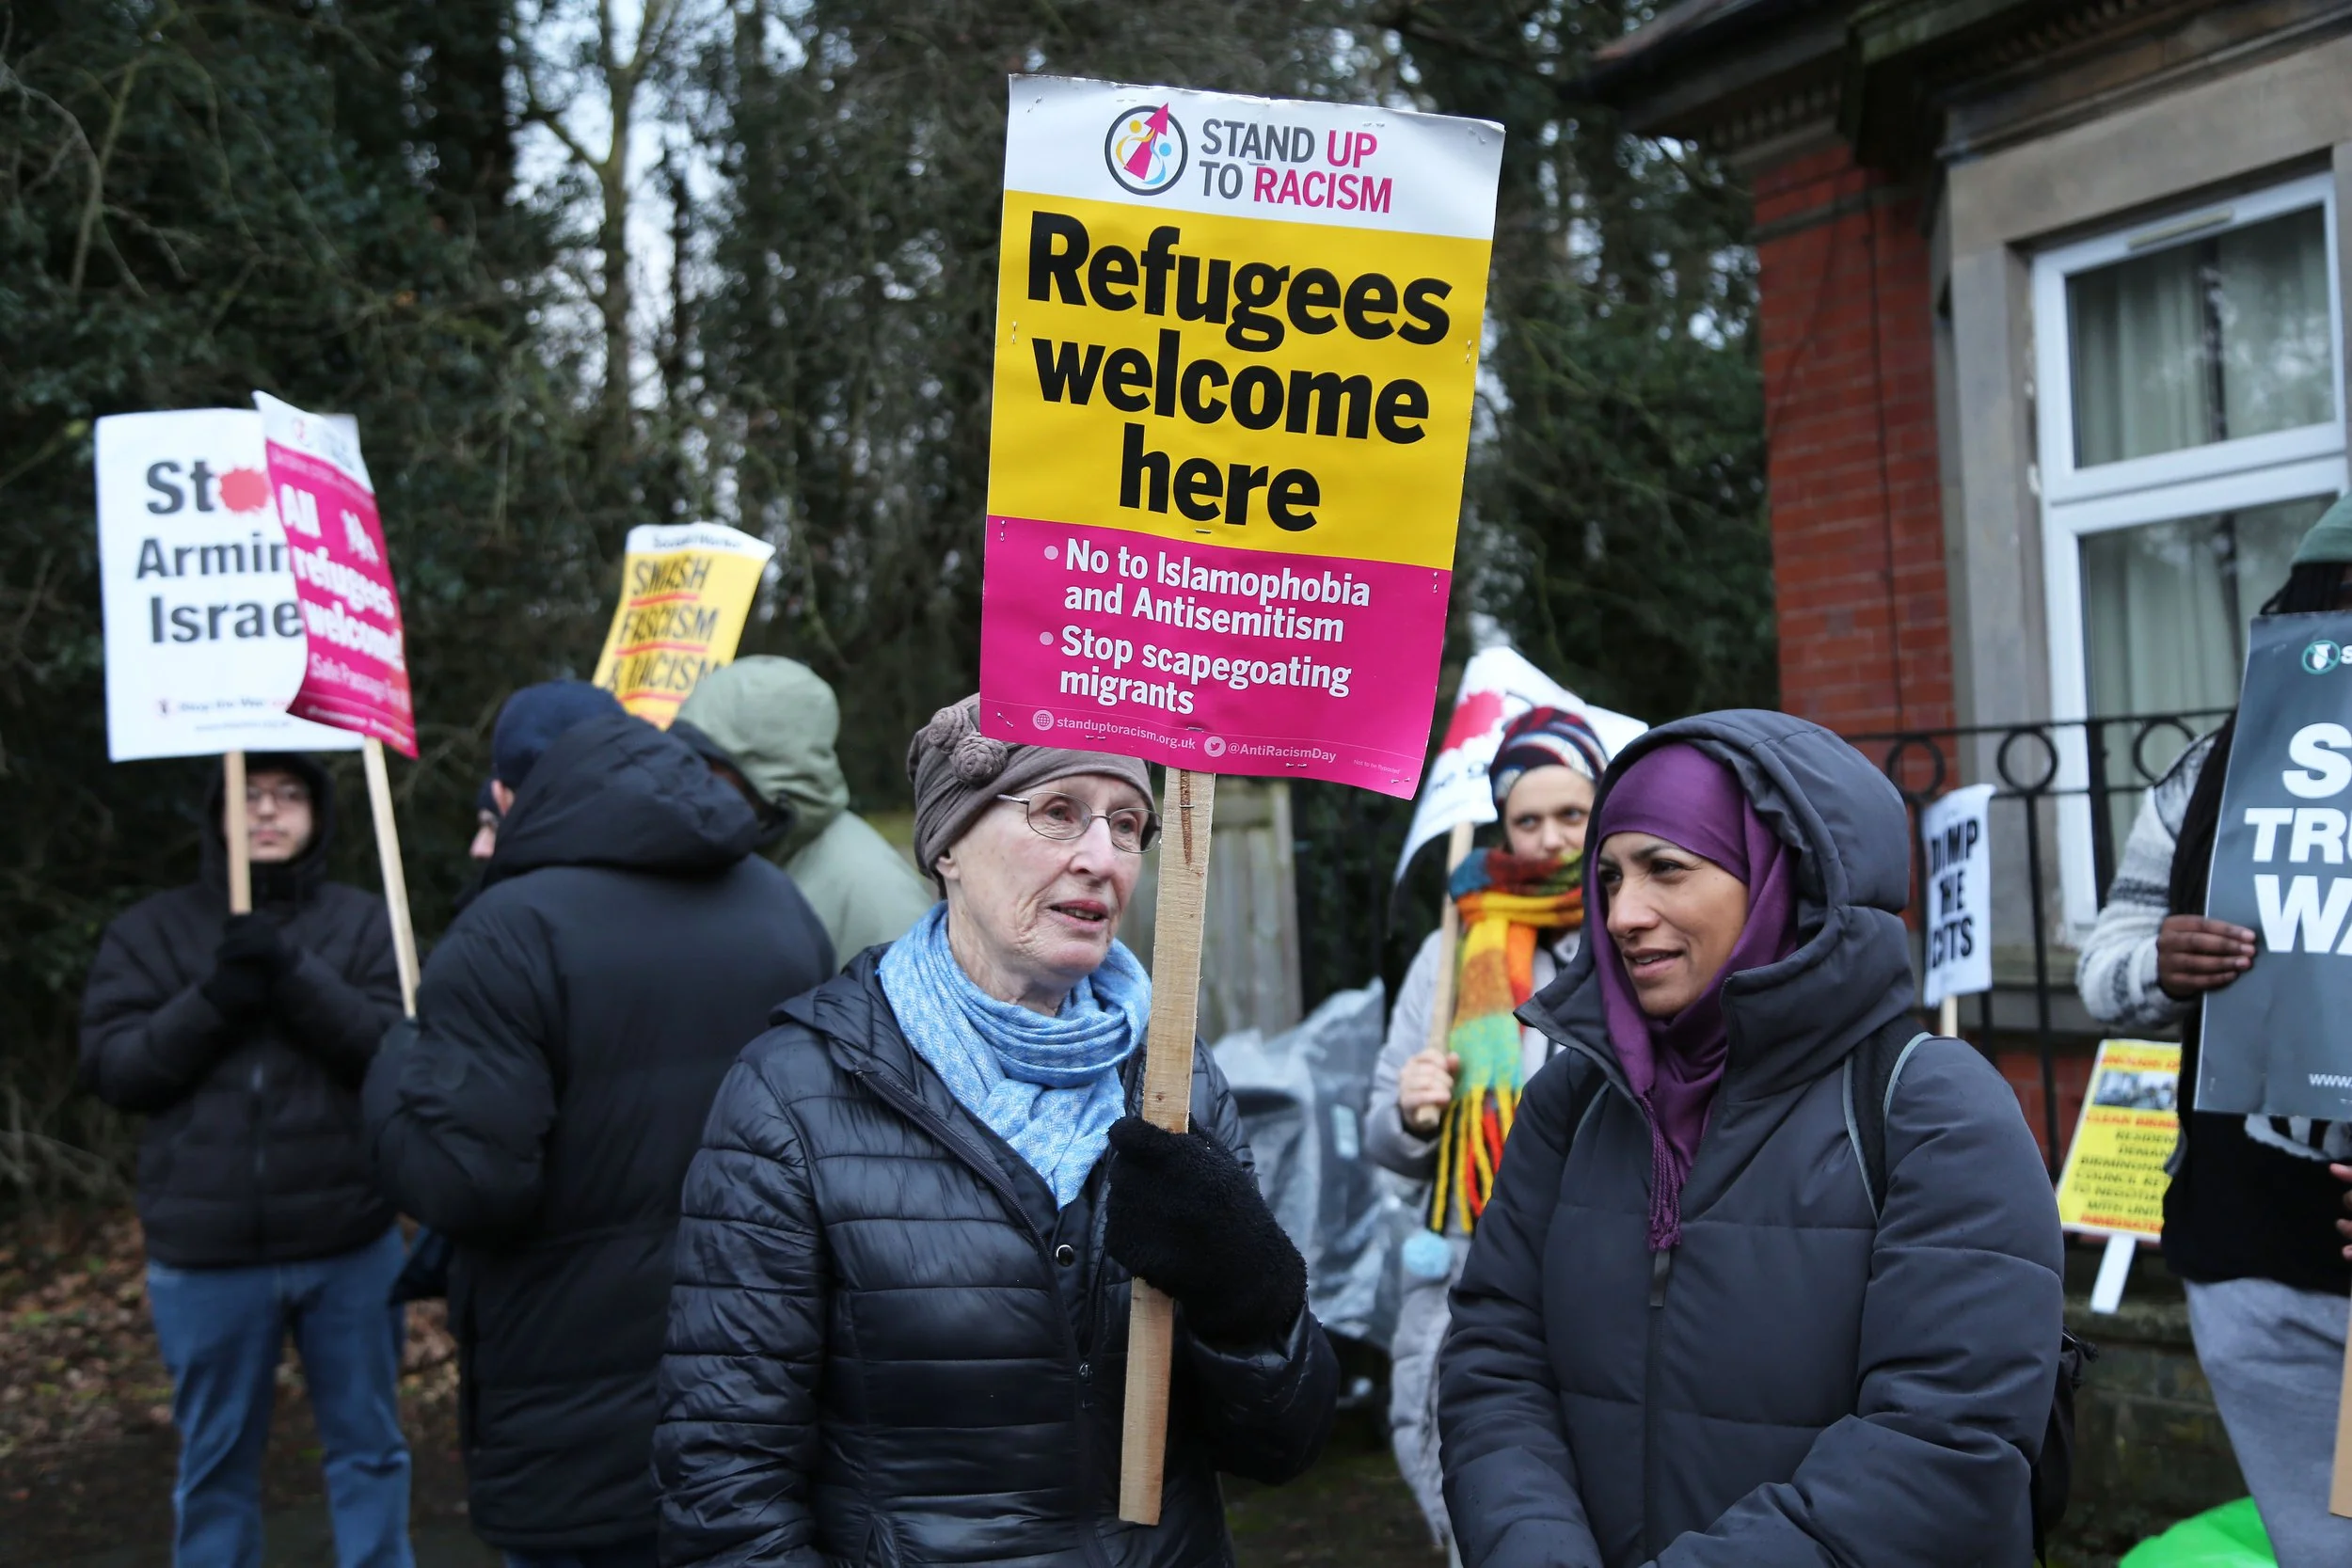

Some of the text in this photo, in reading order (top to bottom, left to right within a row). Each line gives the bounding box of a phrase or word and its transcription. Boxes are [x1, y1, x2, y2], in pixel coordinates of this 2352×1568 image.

[1200, 119, 1378, 169] STAND UP
[1198, 160, 1393, 214] TO RACISM
[1027, 210, 1454, 353] Refugees
[1032, 328, 1430, 445] welcome
[1120, 421, 1321, 532] here
[135, 531, 292, 580] Armin
[1065, 537, 1371, 608] No to Islamophobia
[151, 595, 304, 644] Israe
[1064, 583, 1344, 642] and Antisemitism
[1060, 625, 1352, 698] Stop scapegoating
[1059, 668, 1195, 715] migrants
[1057, 716, 1196, 750] standuptoracism.org.uk
[1228, 742, 1337, 763] @AntiRacismDay
[2244, 807, 2352, 864] TR
[1932, 916, 1973, 969] CTS
[2254, 874, 2352, 957] W
[2308, 1073, 2352, 1088] www.
